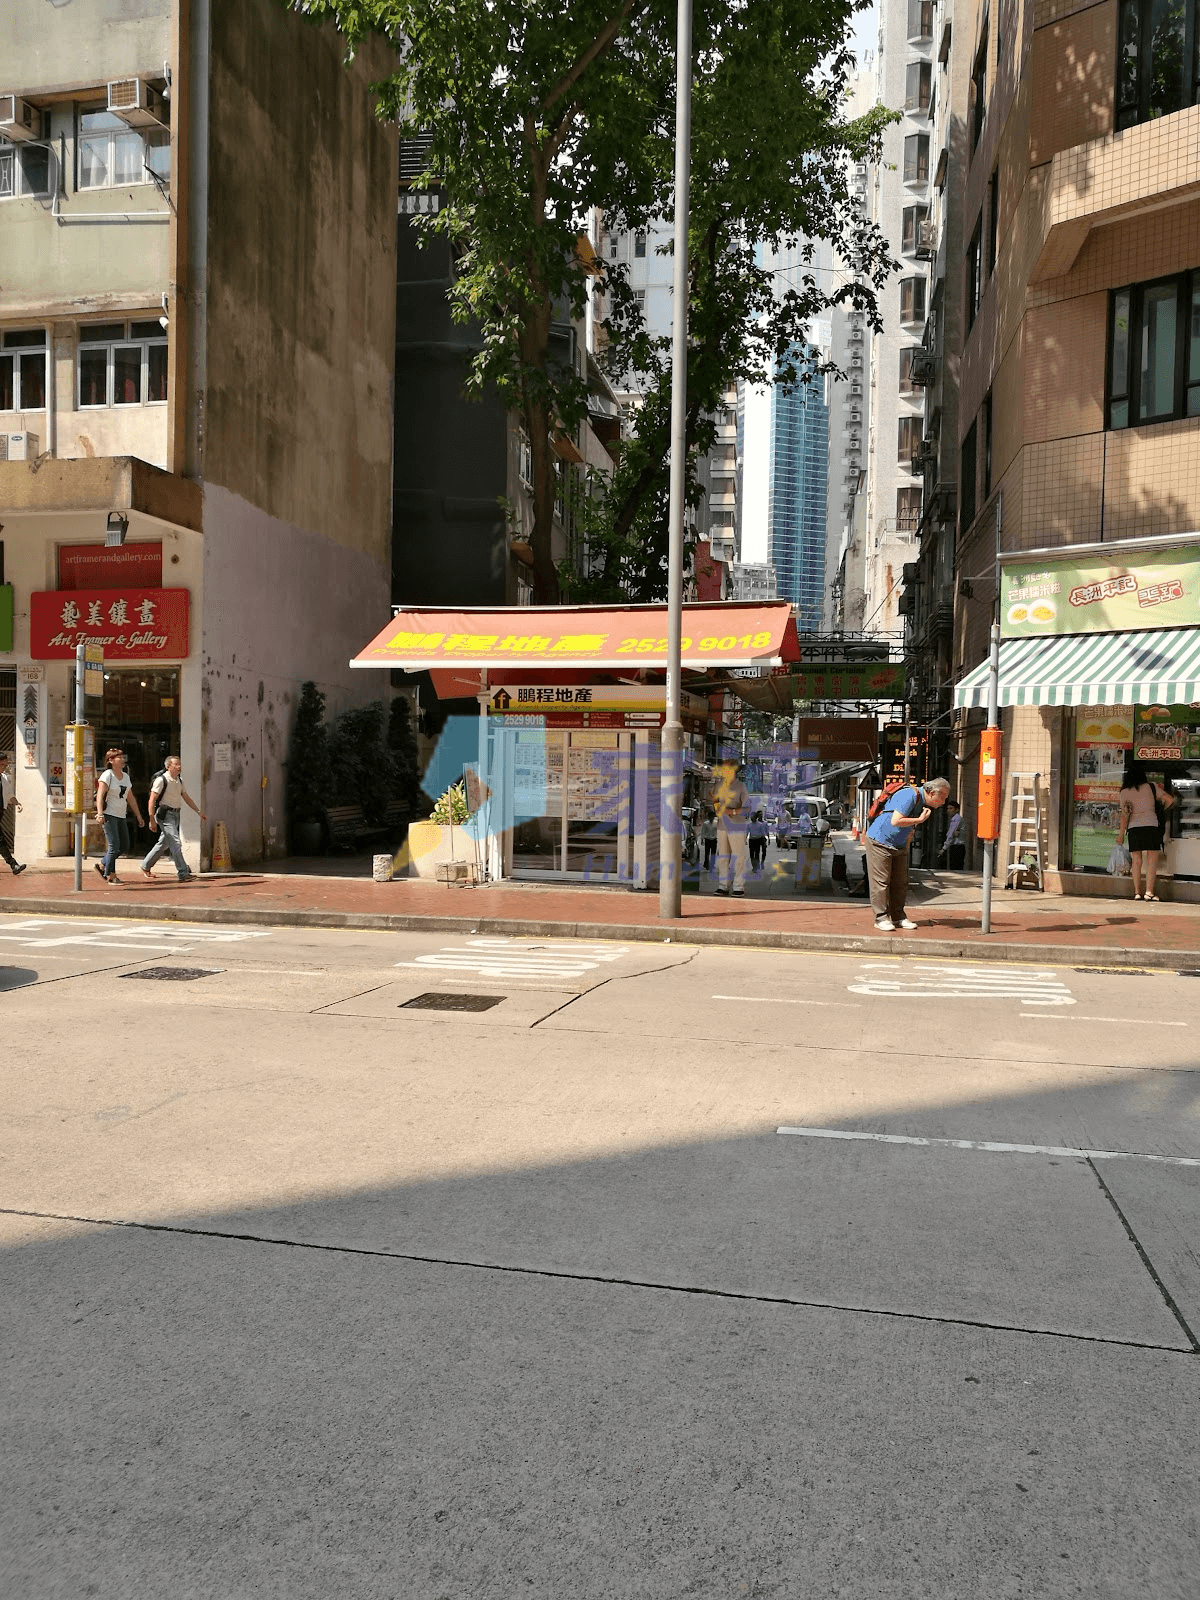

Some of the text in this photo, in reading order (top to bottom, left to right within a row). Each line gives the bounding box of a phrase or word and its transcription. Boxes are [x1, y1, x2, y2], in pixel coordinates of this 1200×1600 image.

[66, 553, 161, 564] artframerandgallery.com
[1070, 576, 1136, 606] 長洲平記
[60, 598, 157, 628] 藝美鑲畫
[48, 631, 168, 649] Art Framer & Gallery
[385, 632, 609, 651] 鵬程地產
[698, 632, 772, 651] 9018
[517, 688, 592, 703] 鵬程地產
[504, 714, 524, 725] 2529
[525, 714, 544, 725] 9018
[1139, 747, 1181, 759] 長洲平記
